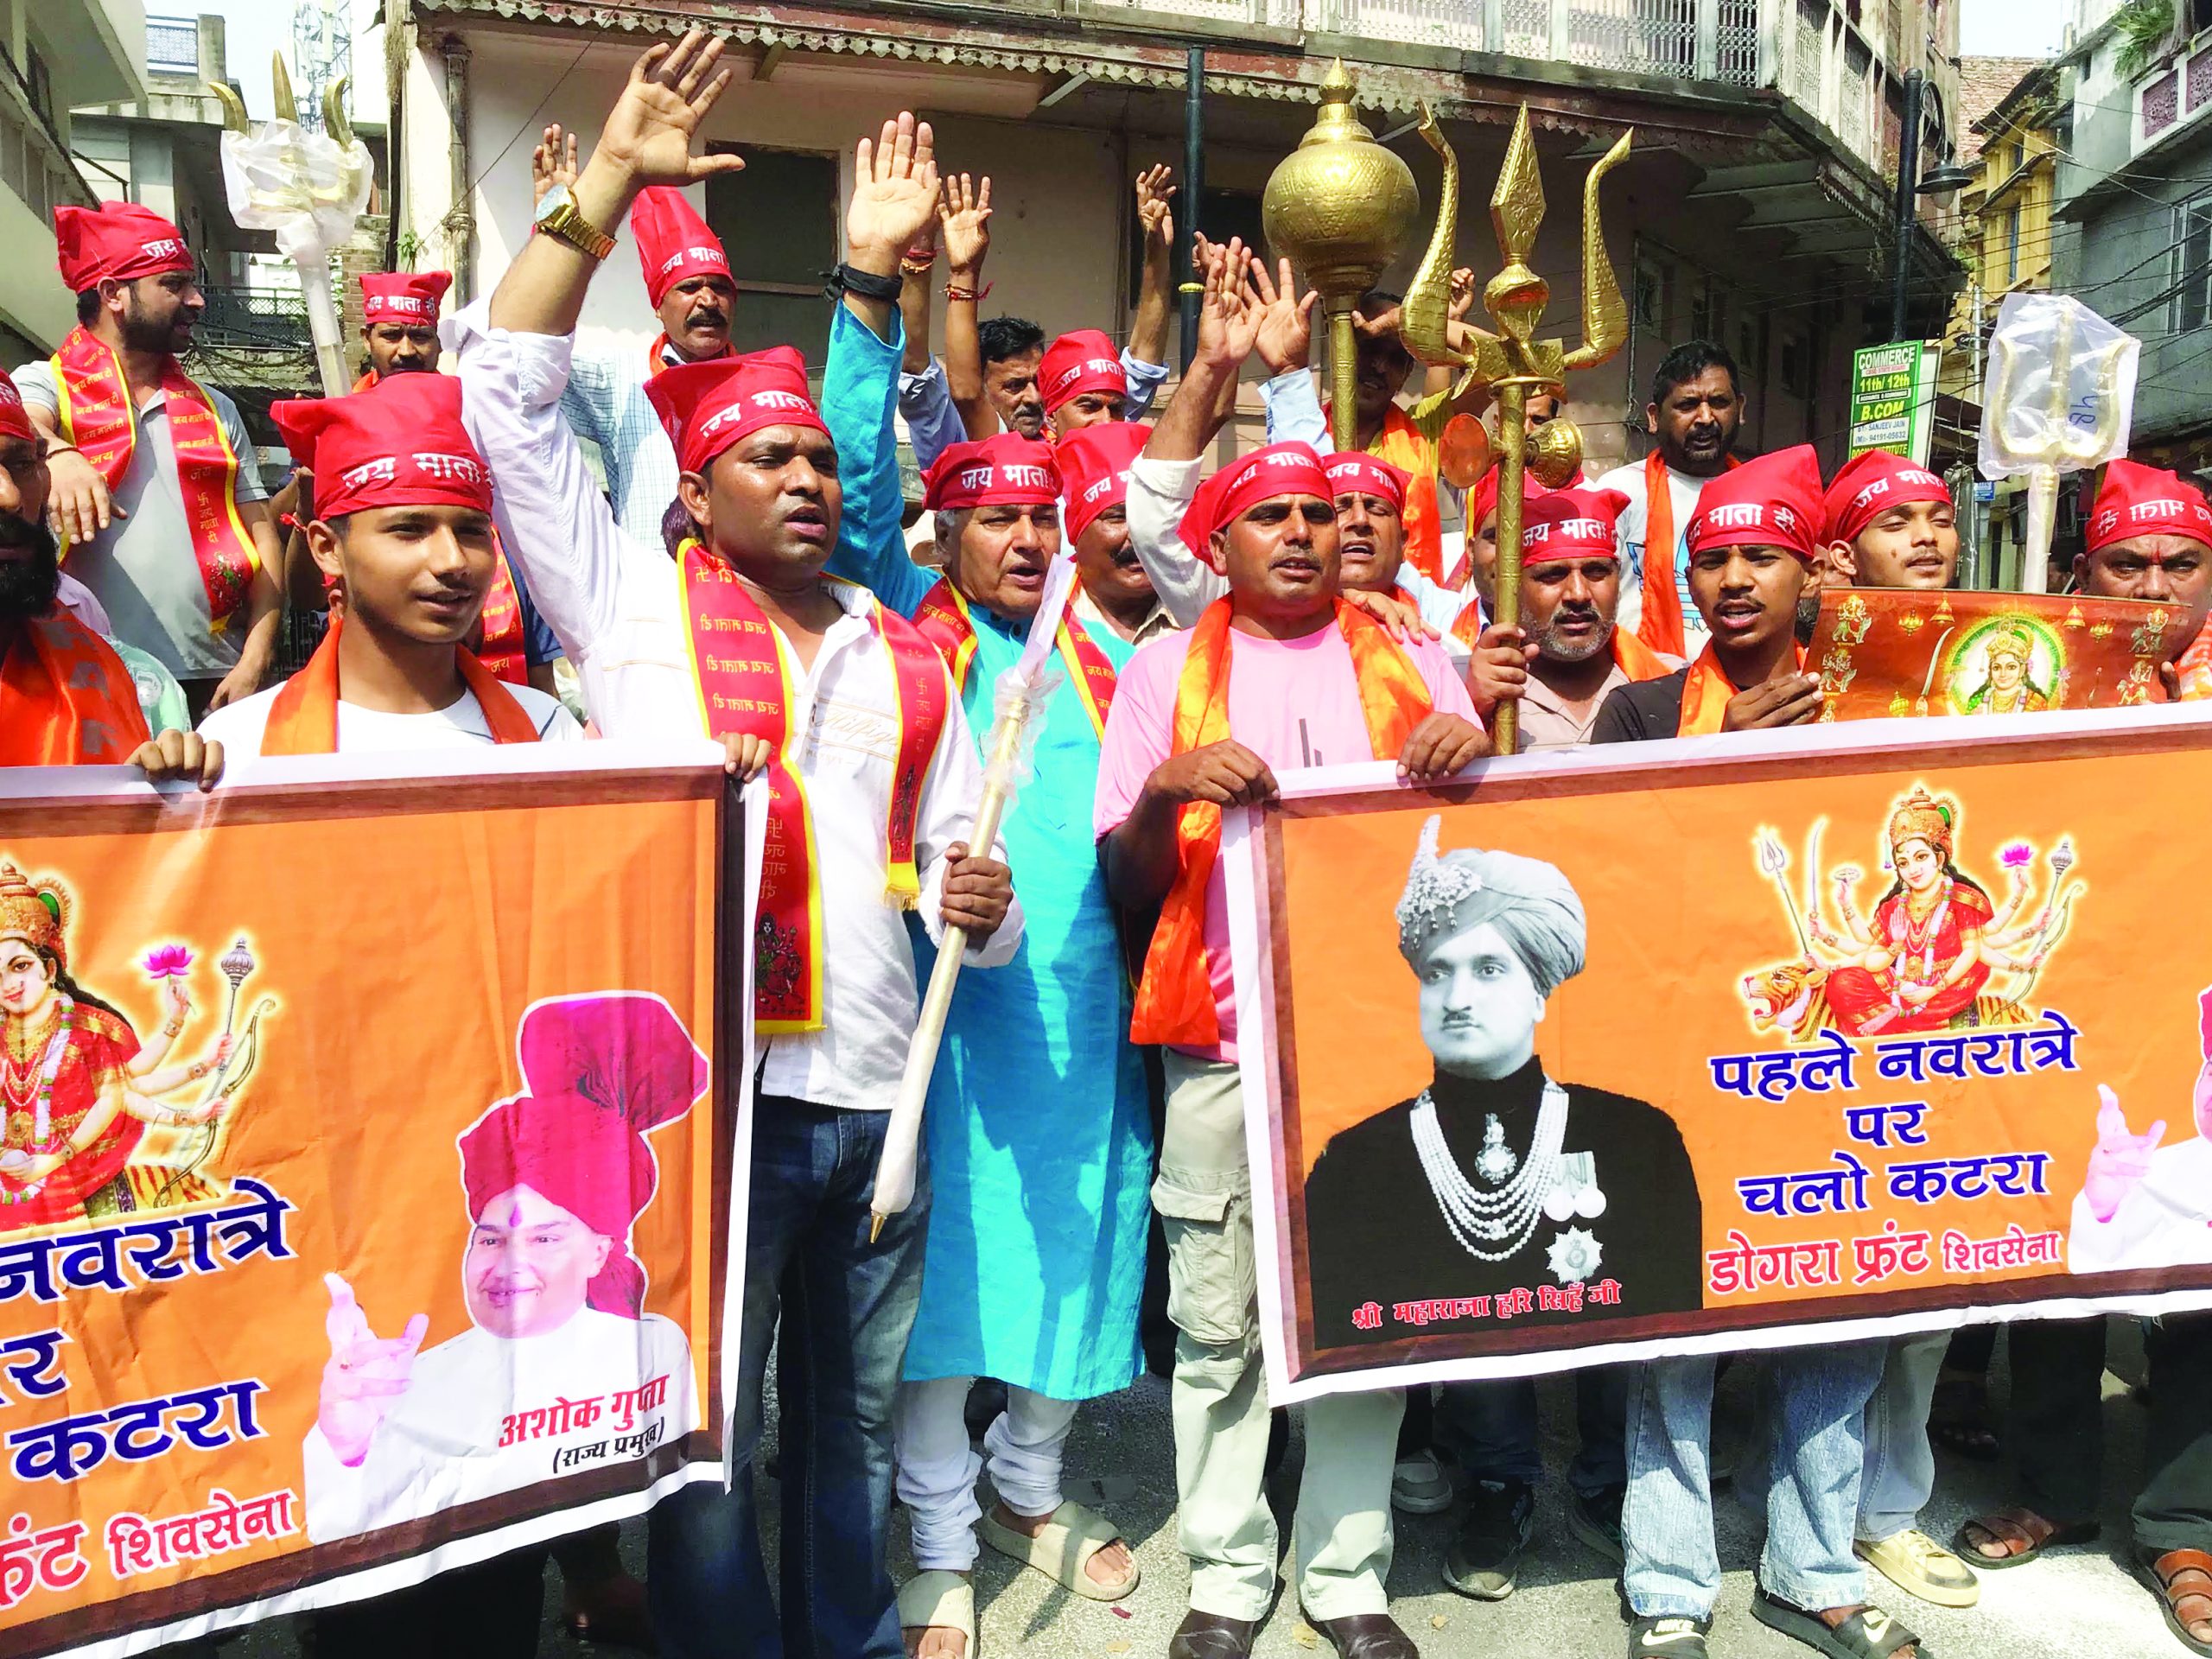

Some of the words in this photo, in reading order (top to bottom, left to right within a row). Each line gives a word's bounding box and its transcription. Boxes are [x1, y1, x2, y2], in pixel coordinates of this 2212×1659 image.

[689, 246, 725, 266] माता
[387, 296, 422, 312] माता
[1087, 359, 1123, 377] माता
[1859, 346, 1916, 370] COMMERCE
[1887, 373, 1910, 389] 12th
[751, 390, 814, 414] माता
[1861, 401, 1904, 421] B.COM
[411, 452, 481, 484] माता
[961, 467, 995, 490] जय
[1002, 464, 1049, 488] माता
[1325, 462, 1362, 479] जय
[1083, 476, 1111, 503] जय
[1852, 477, 1890, 508] जय
[1708, 503, 1764, 527] माता
[1522, 522, 1551, 546] जय
[1559, 518, 1606, 540] माता
[490, 657, 510, 673] जय
[1710, 1029, 1857, 1102] पहले
[1877, 1011, 2078, 1081] नवरात्रे
[1846, 1103, 1929, 1146] पर
[1738, 1152, 1870, 1216] चलो
[1888, 1153, 2052, 1204] कटरा
[1708, 1231, 1842, 1294] डोगरा
[1854, 1220, 1931, 1285] फ्रंट
[1942, 1226, 2063, 1273] शिवसेना
[1352, 1301, 1382, 1329] श्री
[1393, 1295, 1491, 1325] महाराजा
[1495, 1287, 1534, 1319] हरि
[1587, 1278, 1622, 1305] जी
[0, 1330, 66, 1405] र
[499, 1395, 605, 1448] अशोक
[611, 1374, 670, 1432] गुप्ता
[8, 1381, 263, 1481] कटरा
[107, 1491, 296, 1575] शिवसेना
[1655, 1618, 1695, 1633] NIKE
